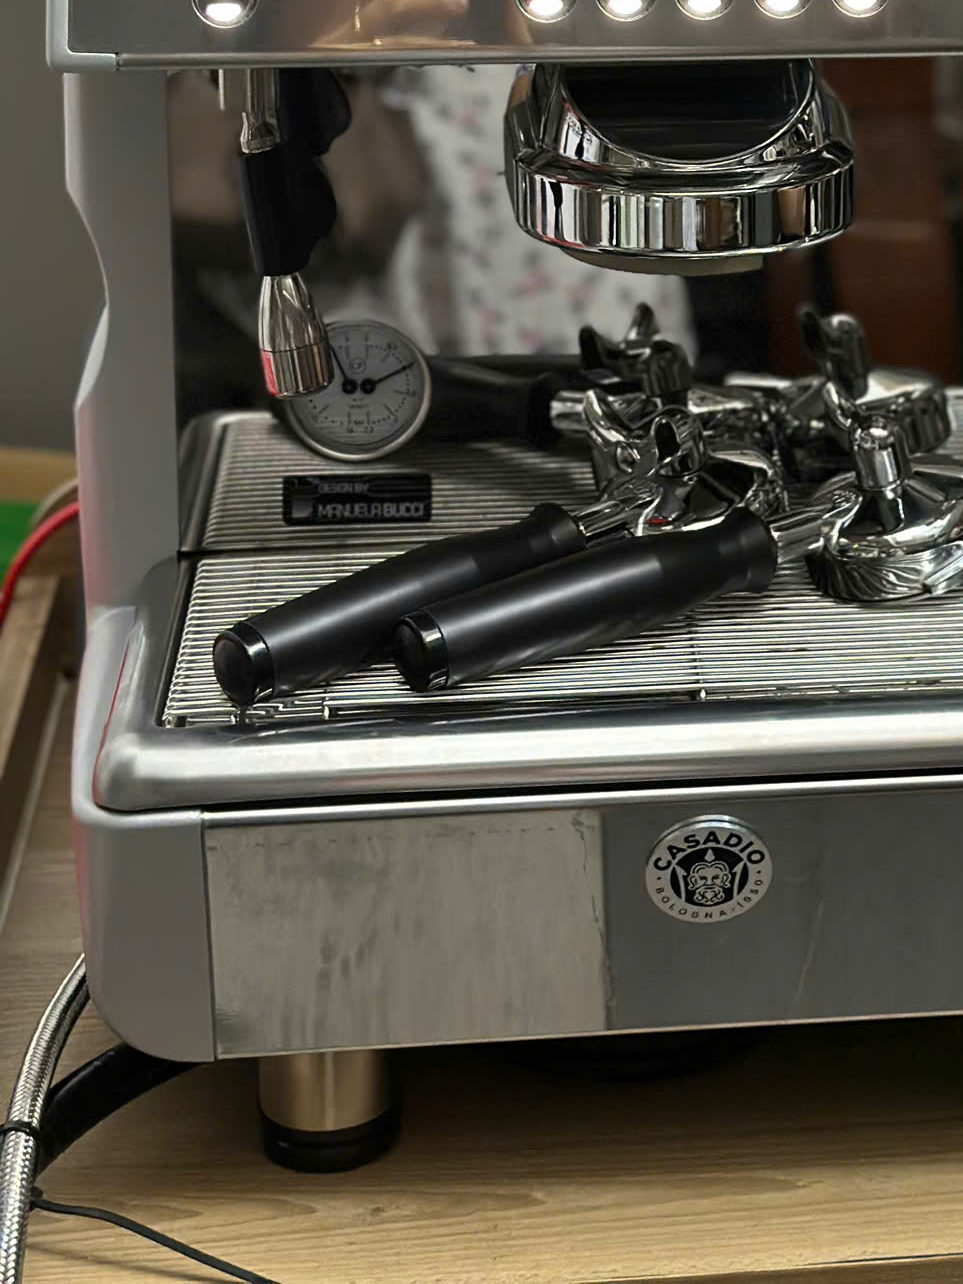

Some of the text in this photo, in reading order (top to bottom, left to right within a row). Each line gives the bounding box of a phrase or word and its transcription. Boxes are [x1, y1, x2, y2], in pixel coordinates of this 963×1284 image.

[354, 482, 370, 493] BY
[318, 502, 425, 518] MANUELA BUCCI
[653, 830, 766, 872] CASADIO
